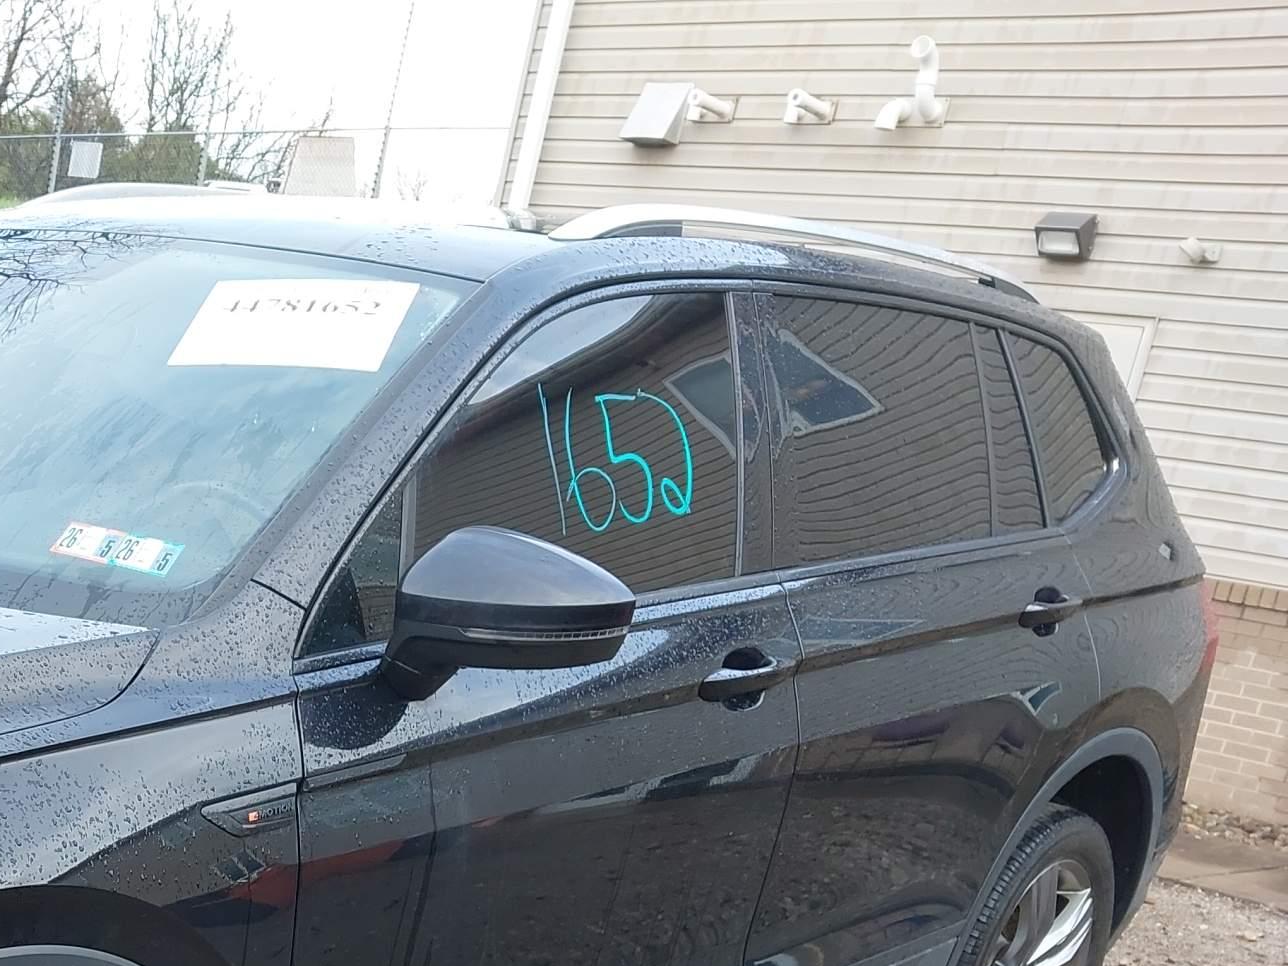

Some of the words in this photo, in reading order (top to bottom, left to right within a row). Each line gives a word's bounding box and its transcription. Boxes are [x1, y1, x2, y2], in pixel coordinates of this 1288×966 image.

[537, 382, 693, 536] 1652
[58, 526, 84, 548] 26
[100, 540, 116, 558] 5
[115, 538, 140, 561] 26
[156, 552, 173, 571] 5
[248, 799, 295, 822] MOTION
